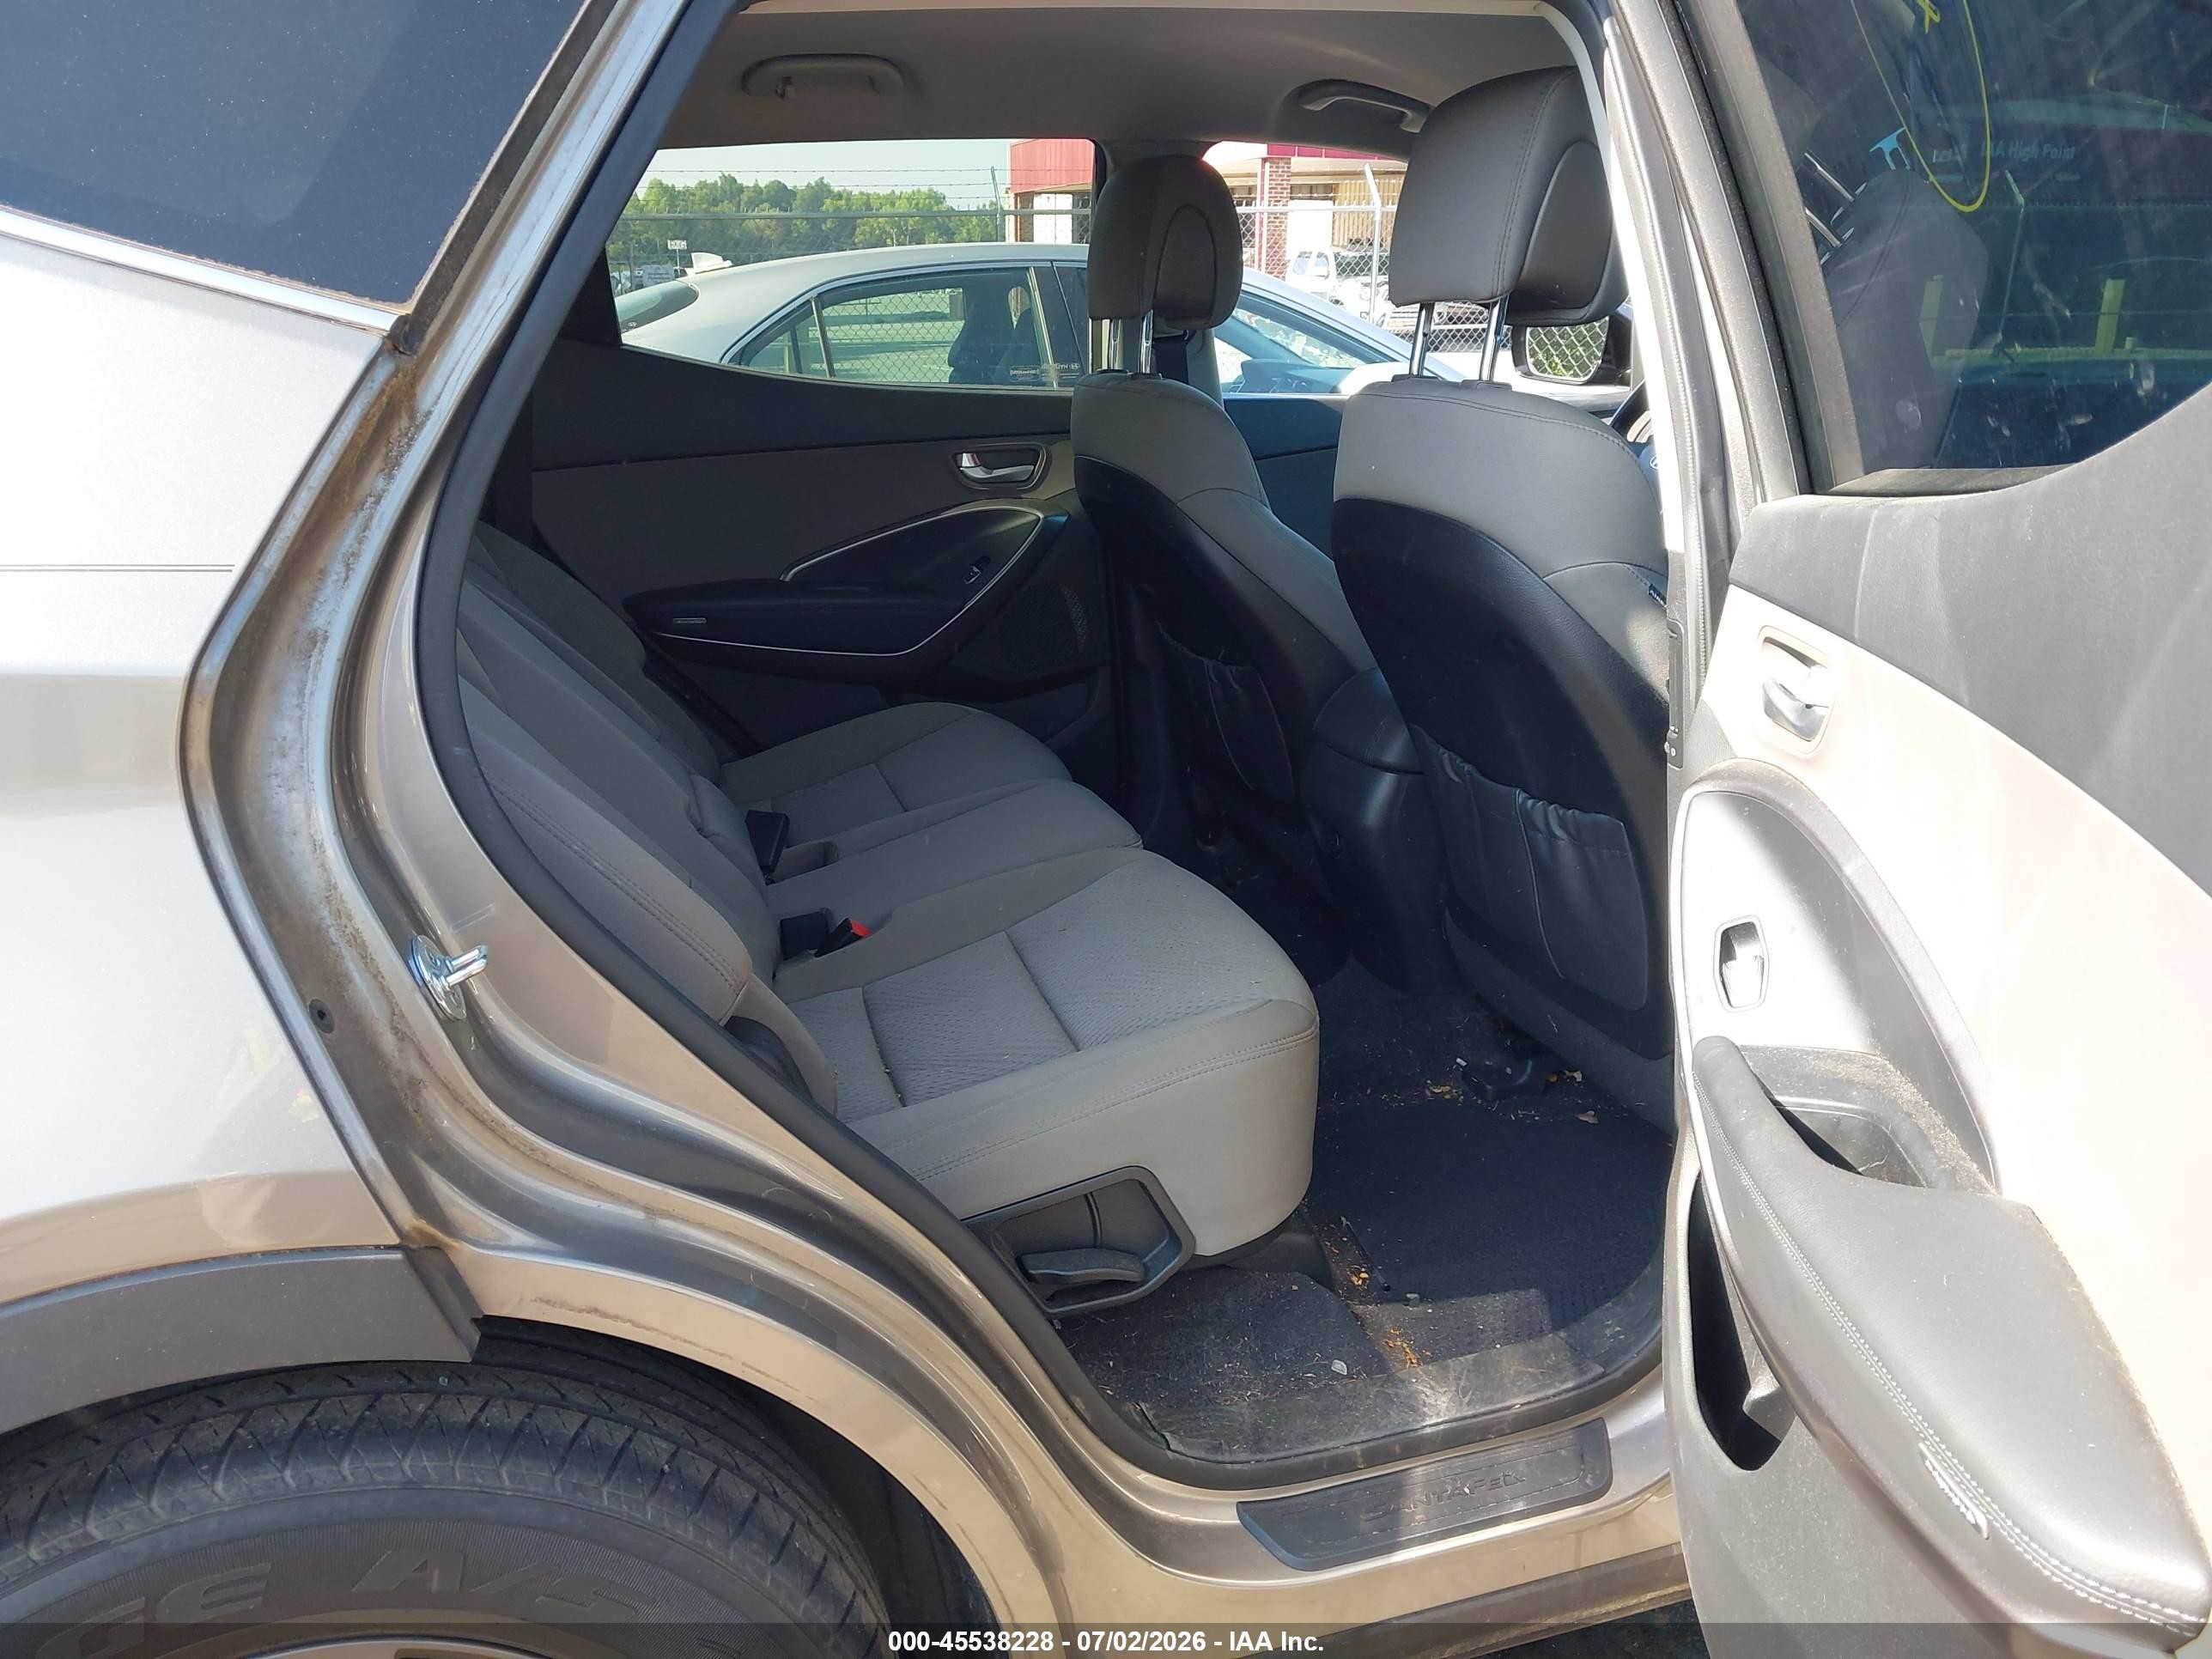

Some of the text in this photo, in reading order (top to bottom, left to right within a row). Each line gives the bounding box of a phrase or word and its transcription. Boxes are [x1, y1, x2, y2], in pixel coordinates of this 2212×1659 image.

[2008, 140, 2040, 161] High
[2042, 143, 2075, 160] Point
[350, 1550, 657, 1622] A/S
